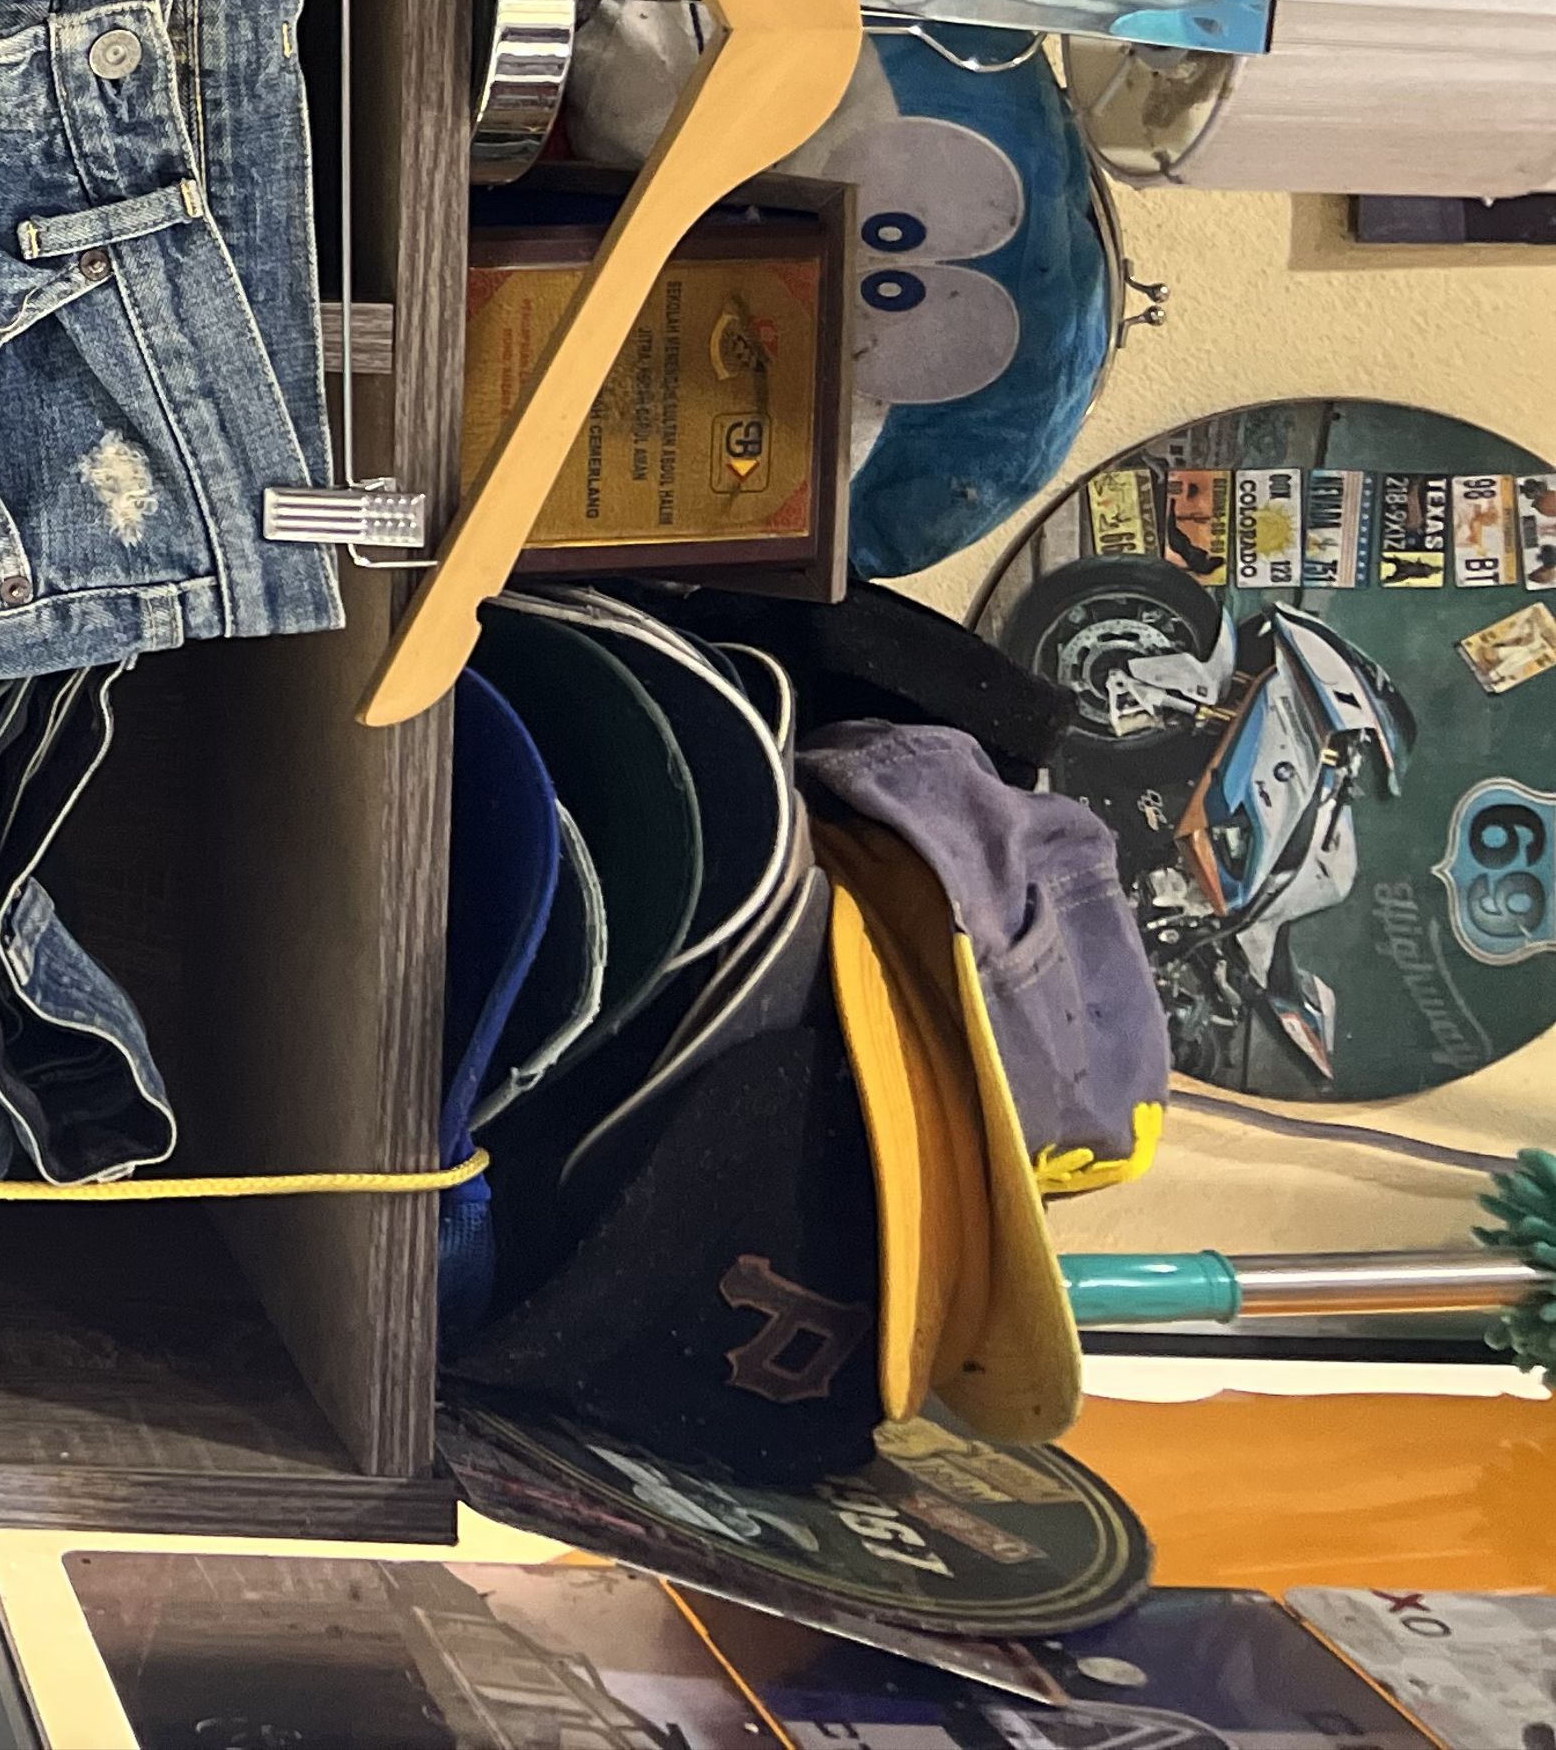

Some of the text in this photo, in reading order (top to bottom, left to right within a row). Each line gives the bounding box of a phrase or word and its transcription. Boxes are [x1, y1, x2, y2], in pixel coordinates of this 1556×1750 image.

[665, 281, 682, 333] SEKOLAH
[585, 424, 602, 519] CEMERLANG
[1425, 478, 1447, 550] TEXAS
[1239, 479, 1257, 578] COLORADO
[1466, 803, 1546, 938] 69
